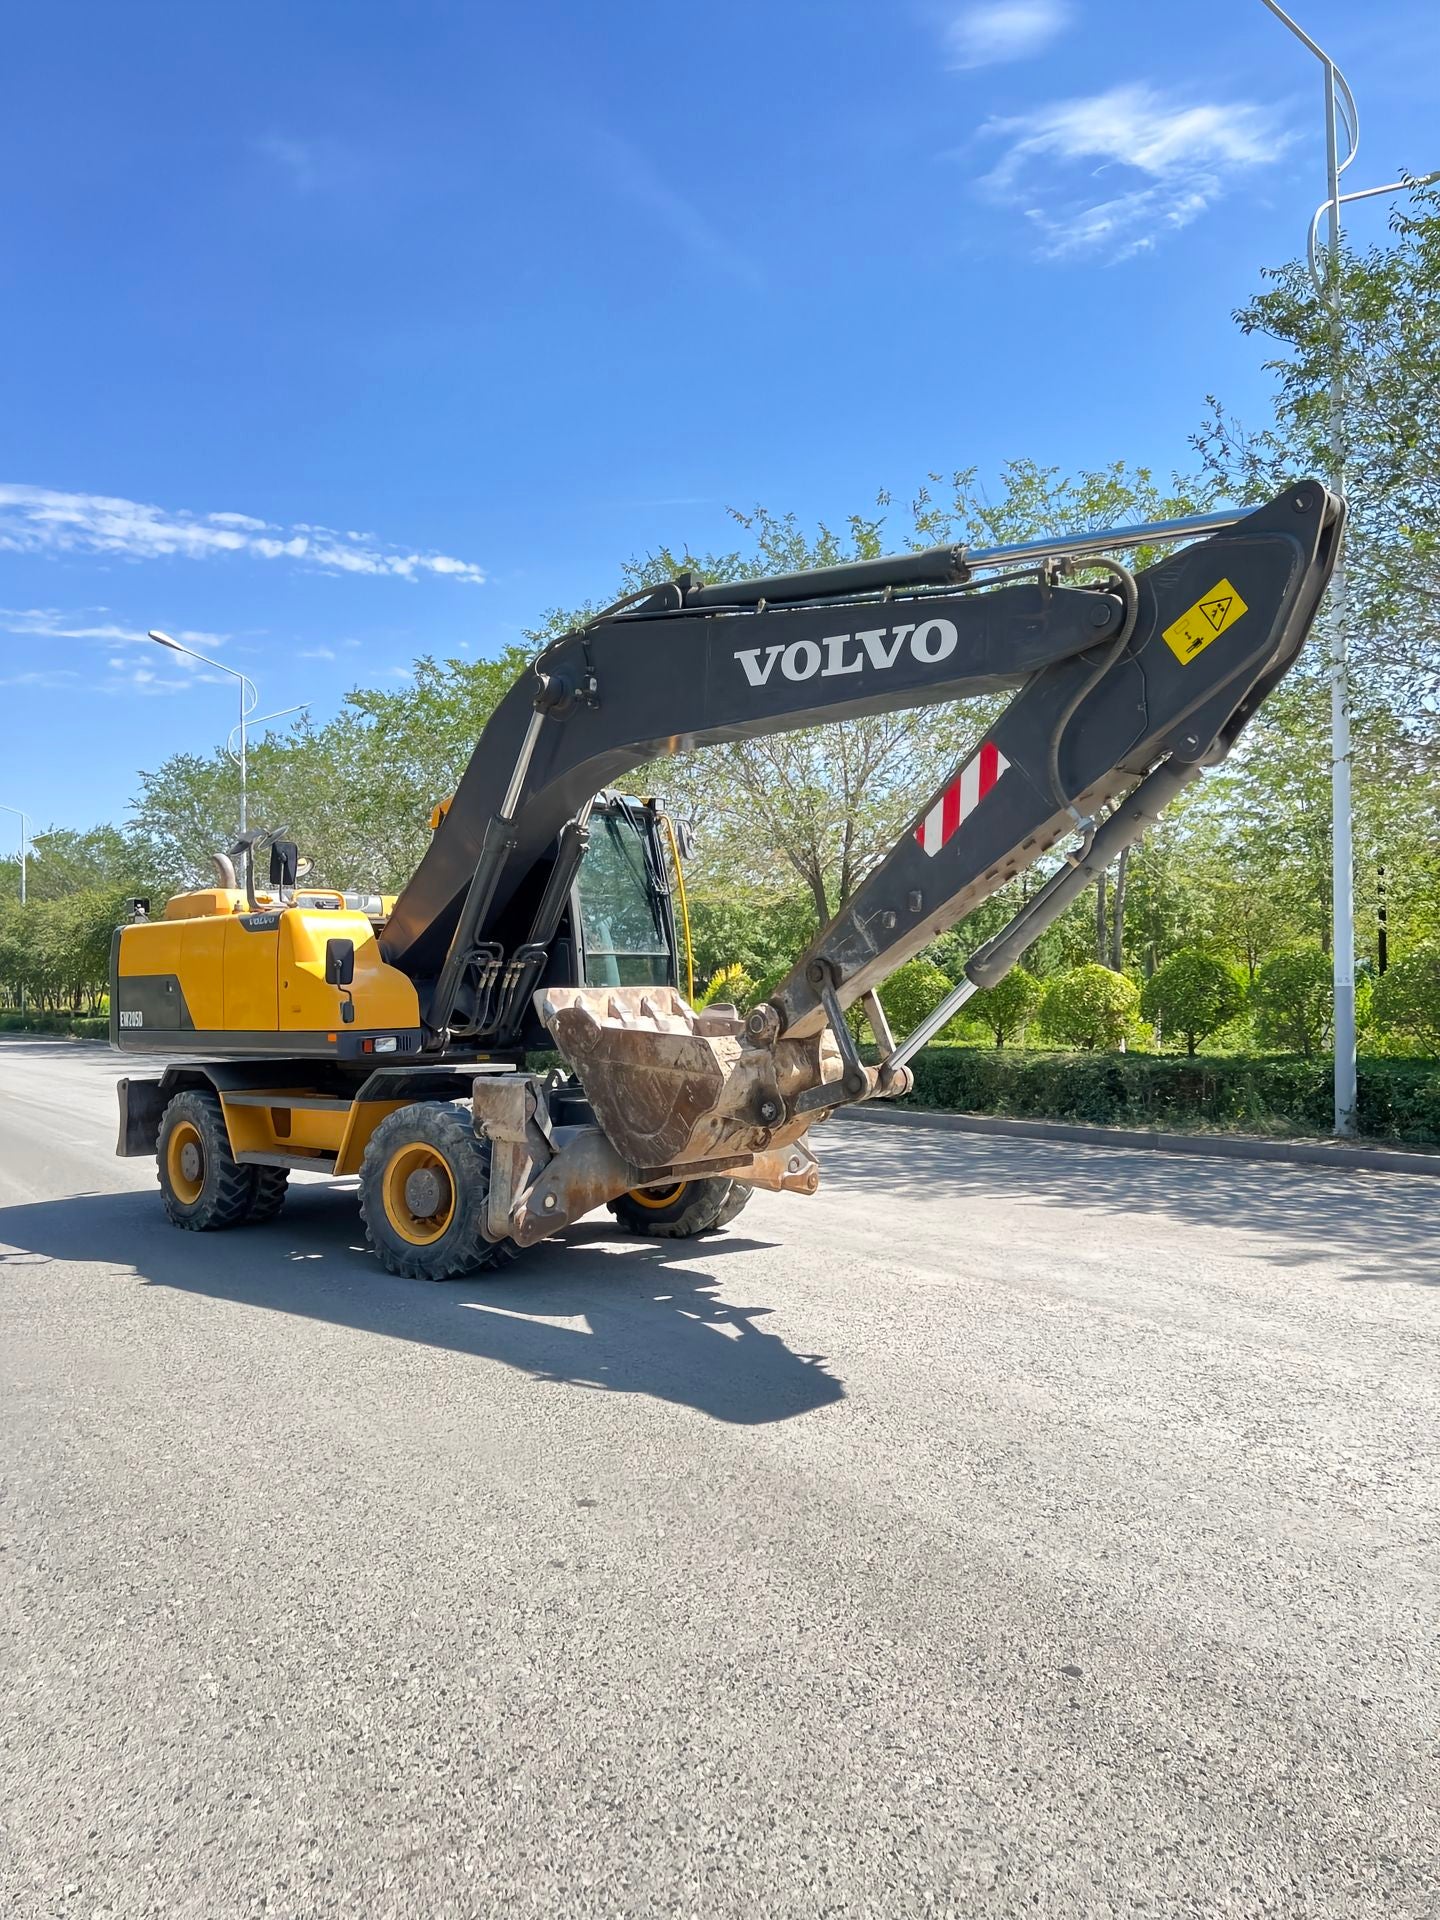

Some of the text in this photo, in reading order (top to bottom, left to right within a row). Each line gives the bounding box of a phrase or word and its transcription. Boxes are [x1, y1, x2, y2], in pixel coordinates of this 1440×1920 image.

[734, 618, 958, 686] VOLVO
[249, 916, 275, 926] VOLVO
[120, 1011, 143, 1027] EW205D
